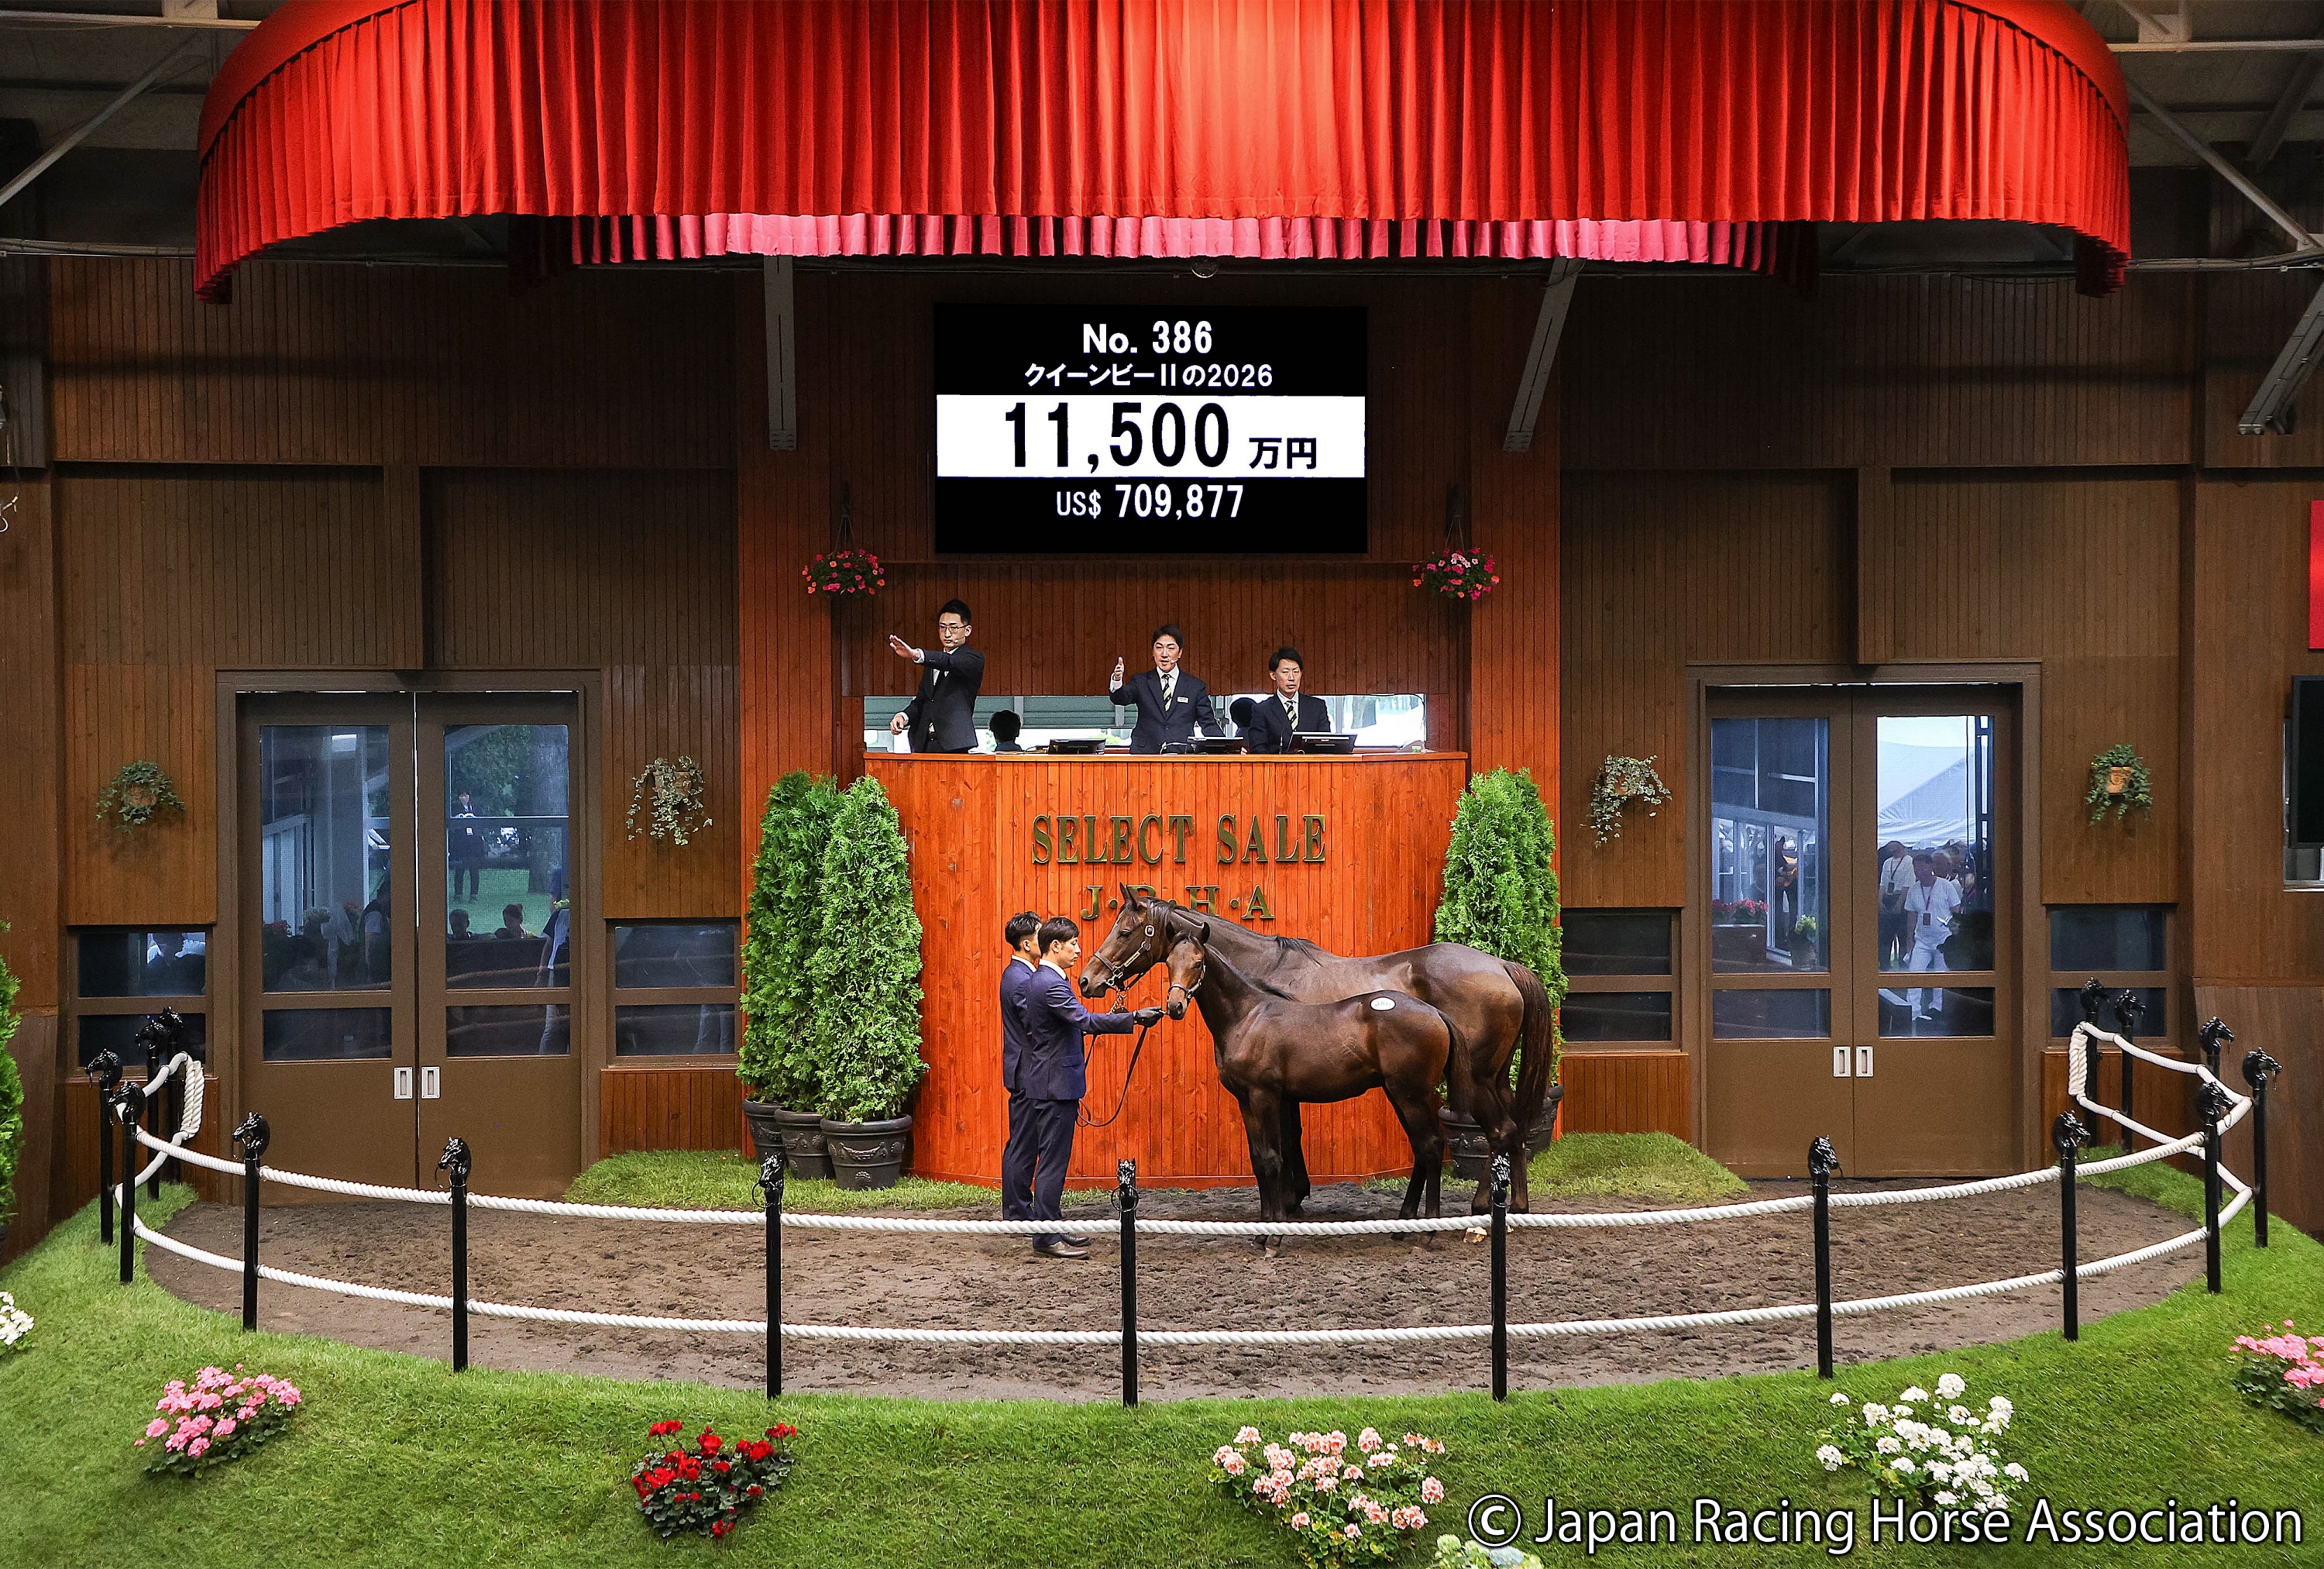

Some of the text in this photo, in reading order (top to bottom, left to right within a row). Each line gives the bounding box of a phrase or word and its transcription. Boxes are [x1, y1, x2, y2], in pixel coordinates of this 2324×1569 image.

[1083, 320, 1212, 354] No. 386
[1005, 401, 1317, 474] 11,500 万円
[1057, 483, 1243, 521] US$ 709,877
[1032, 814, 1325, 865] SELECT SALE
